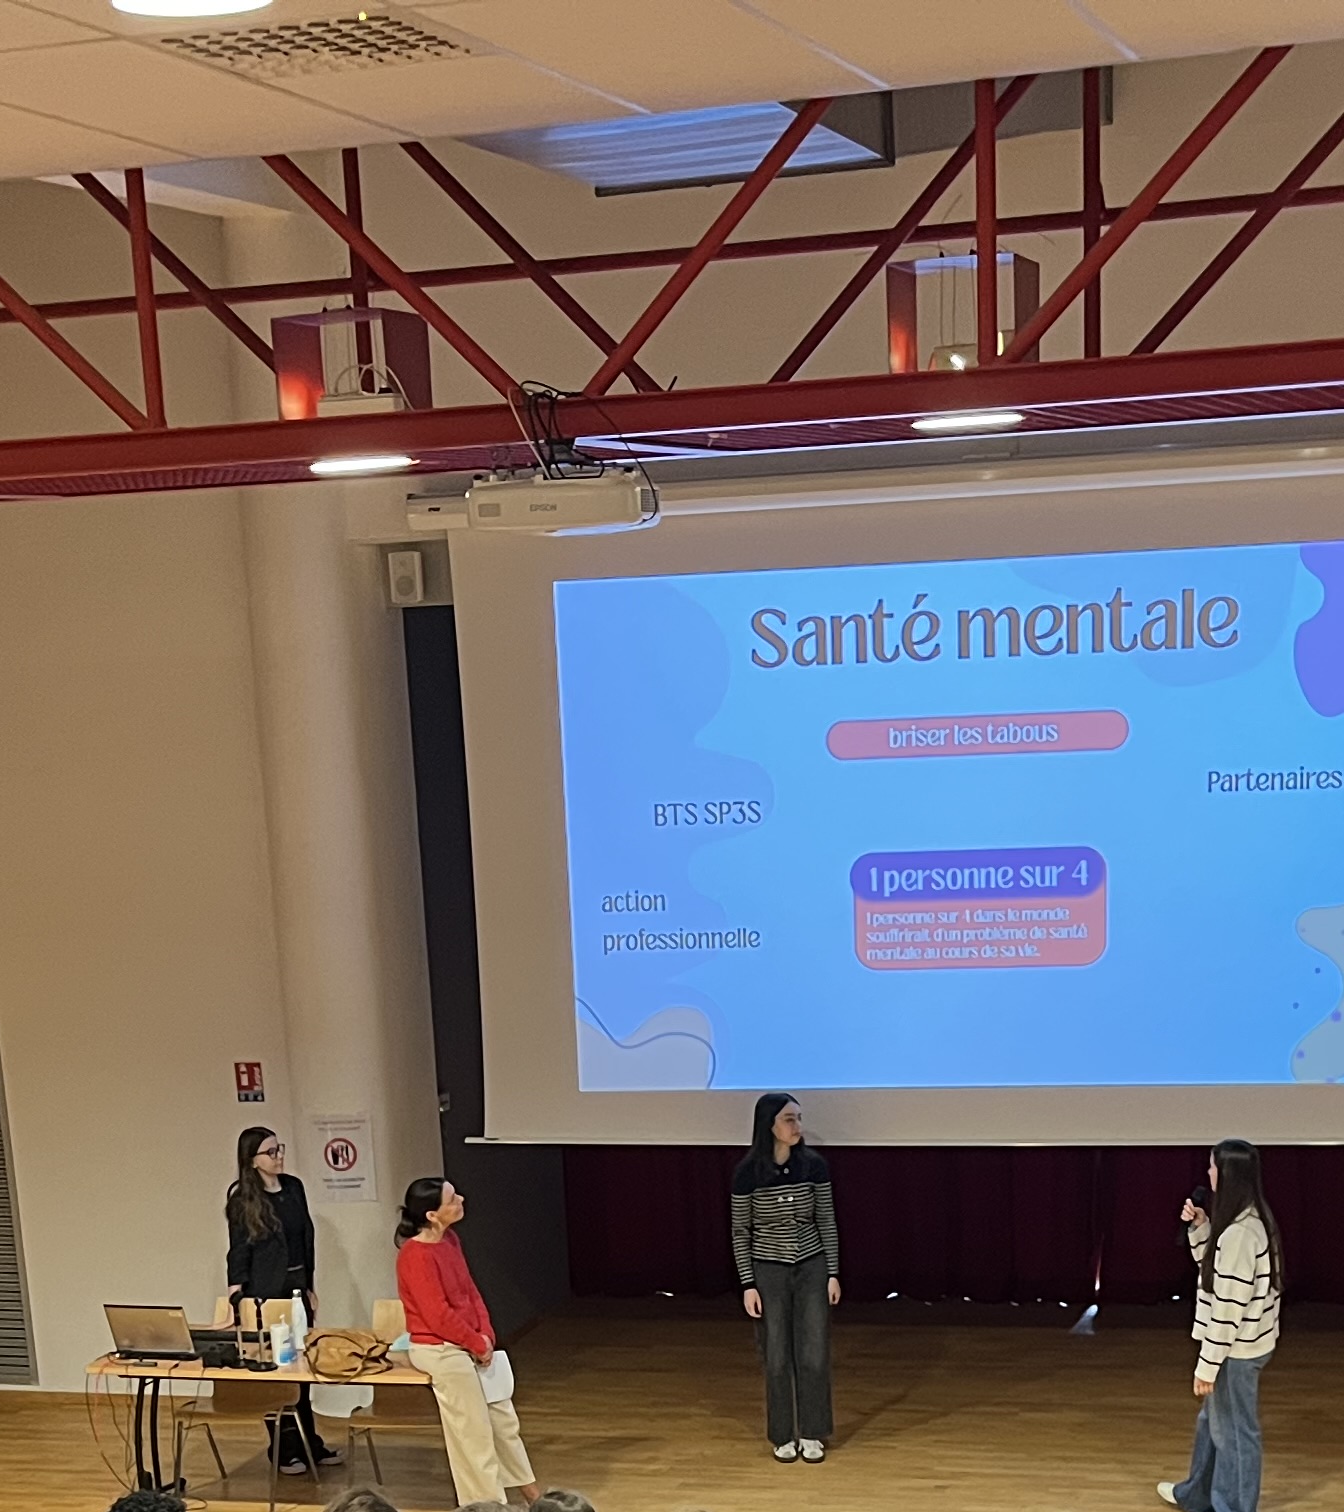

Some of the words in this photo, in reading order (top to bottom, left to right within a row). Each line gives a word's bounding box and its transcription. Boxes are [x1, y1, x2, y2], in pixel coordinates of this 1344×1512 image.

[751, 593, 941, 669] Santé
[956, 586, 1240, 660] mentale
[888, 724, 950, 748] briser
[953, 724, 983, 745] les
[986, 722, 1059, 744] tabous
[1207, 765, 1343, 793] Partenaires
[653, 801, 699, 826] BTS
[703, 800, 762, 825] SP3S
[869, 867, 878, 892] 1
[883, 864, 1014, 898] personne
[1019, 864, 1065, 888] sur
[1071, 859, 1089, 886] 4
[600, 889, 667, 914] action
[873, 912, 935, 928] personne
[937, 911, 959, 924] sur
[973, 908, 1006, 922] dans
[1007, 907, 1020, 921] le
[1021, 907, 1070, 921] monde
[602, 927, 761, 956] professionnelle
[1029, 926, 1047, 940] de
[1048, 923, 1089, 940] santé
[866, 946, 922, 960] mentale
[923, 947, 941, 960] au
[942, 946, 979, 959] cours
[980, 944, 999, 958] de
[999, 945, 1016, 958] sa
